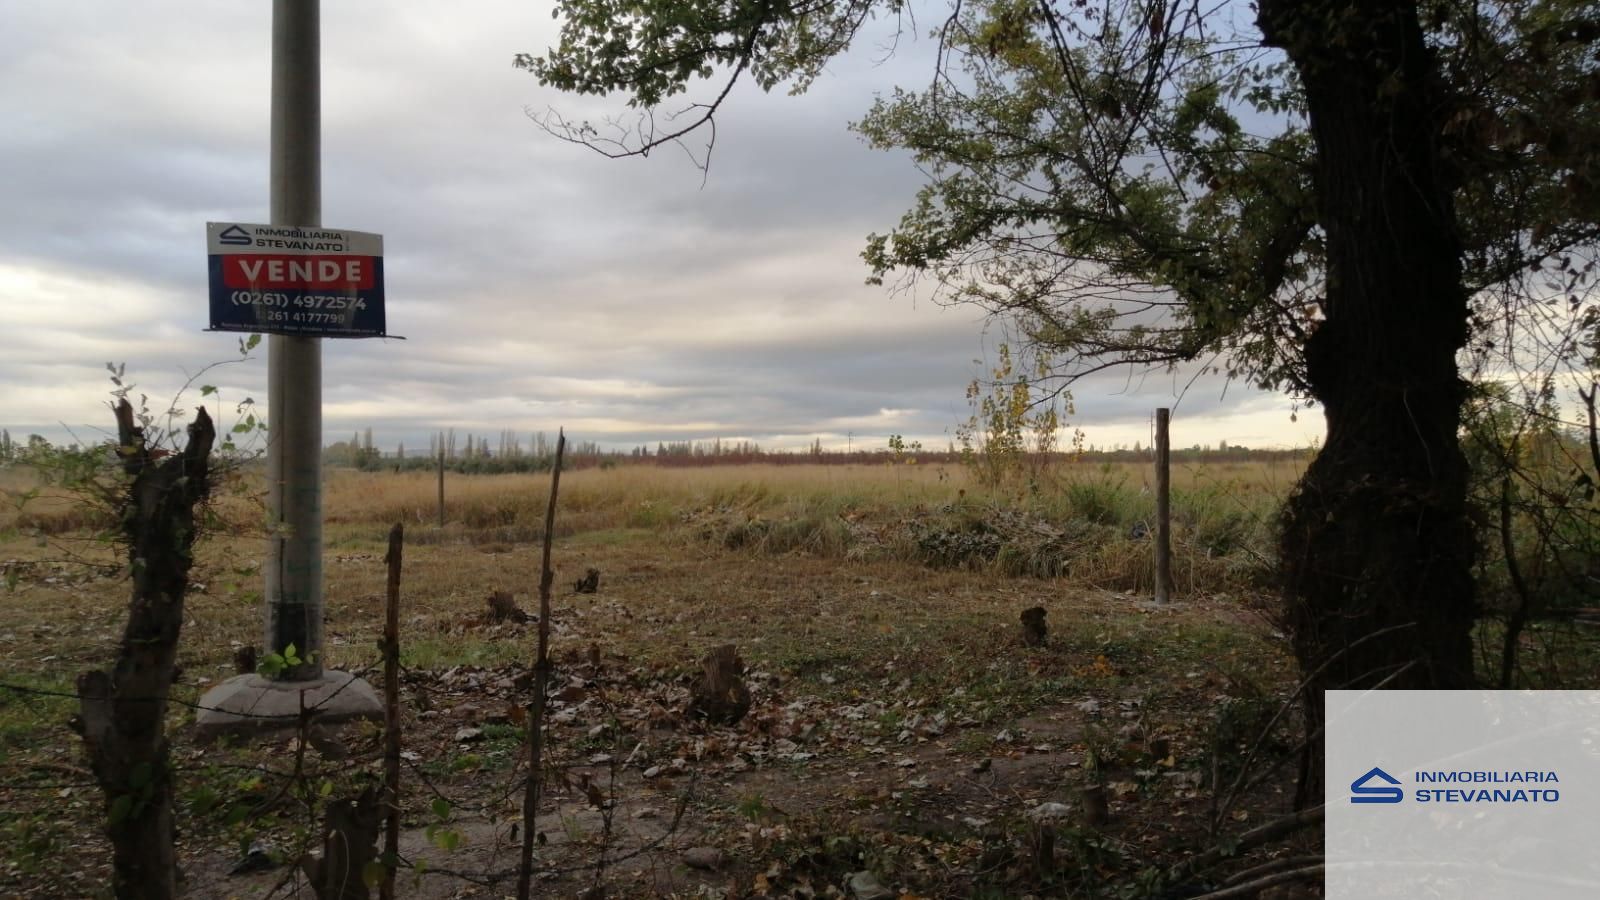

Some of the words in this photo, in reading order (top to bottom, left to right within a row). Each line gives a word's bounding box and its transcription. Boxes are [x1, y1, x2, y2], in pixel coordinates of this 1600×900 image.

[255, 228, 342, 240] INMOBILIARIA
[255, 239, 343, 251] STEVANATO
[239, 260, 361, 282] VENDE
[231, 291, 287, 308] (0261)
[293, 295, 367, 310] 4972574
[268, 311, 289, 321] 261
